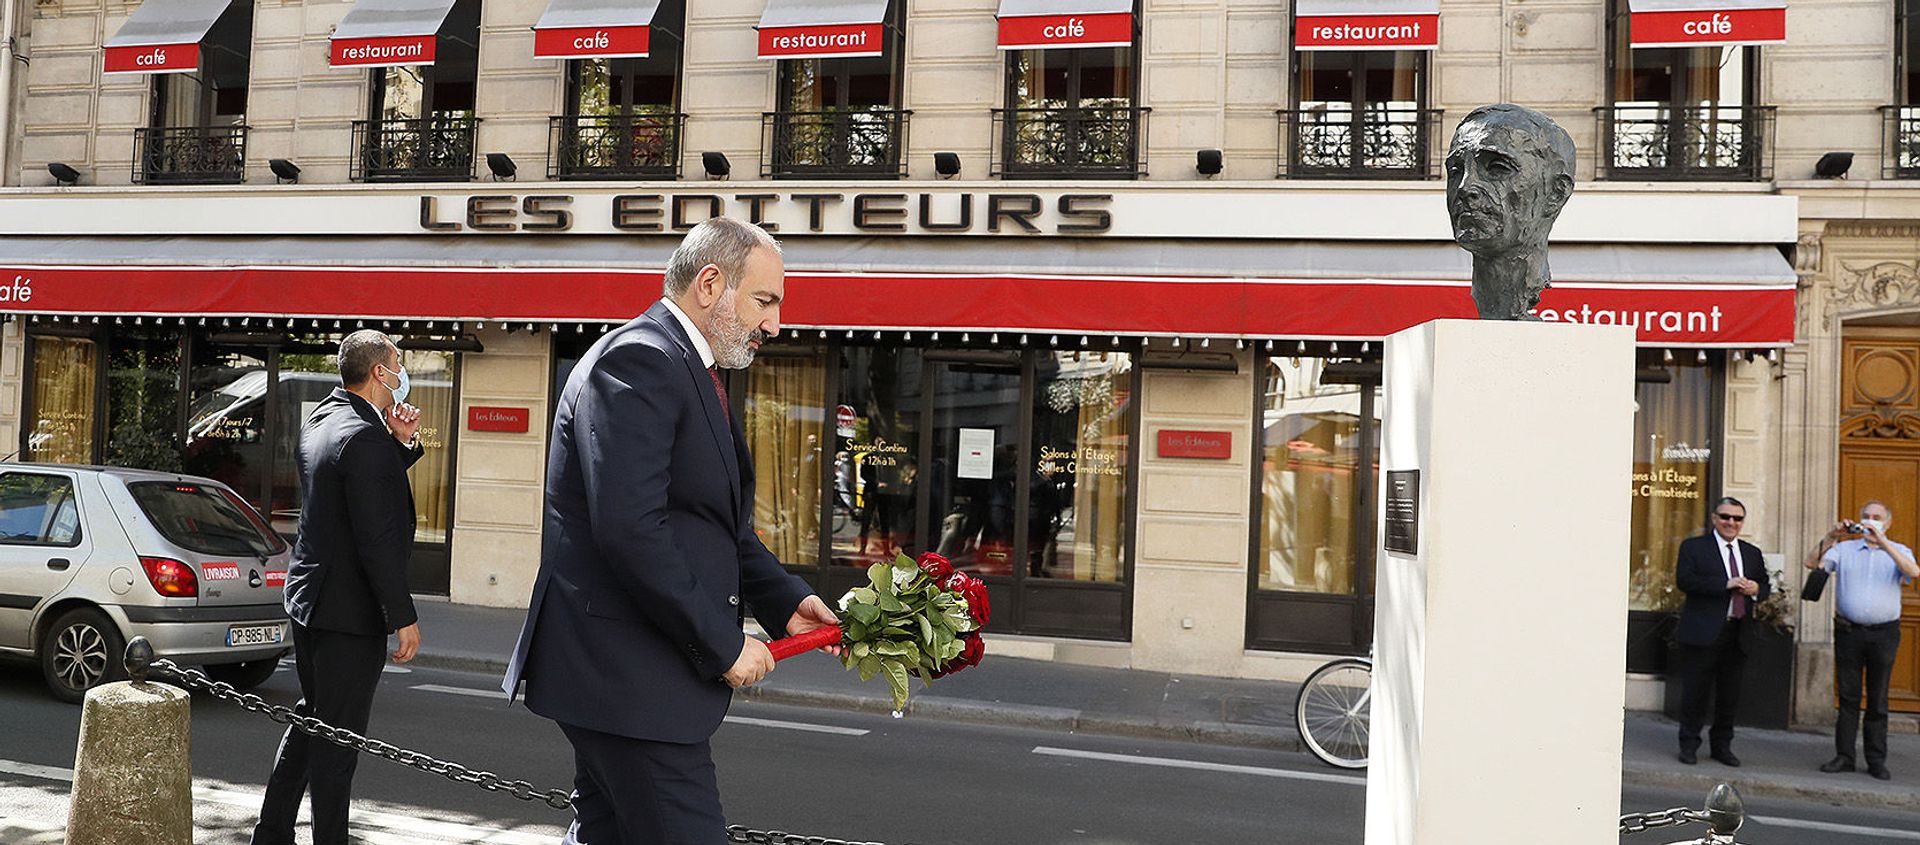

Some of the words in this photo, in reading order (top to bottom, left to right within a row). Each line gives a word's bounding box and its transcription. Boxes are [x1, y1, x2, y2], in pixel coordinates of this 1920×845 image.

[1043, 18, 1085, 38] café
[1312, 22, 1420, 40] restaurant
[1683, 13, 1732, 35] café
[573, 31, 609, 49] café
[772, 30, 867, 49] restaurant
[136, 48, 166, 66] café
[342, 42, 422, 59] restaurant
[419, 195, 574, 231] LES
[611, 193, 1115, 234] EDITEURS
[0, 275, 31, 302] afé
[1528, 303, 1723, 332] estaurant
[845, 438, 877, 453] Service
[878, 440, 908, 453] Continu
[1040, 445, 1070, 459] Salons
[1070, 449, 1078, 459] à
[1037, 460, 1065, 474] Salles
[203, 566, 240, 581] LIVRAISON
